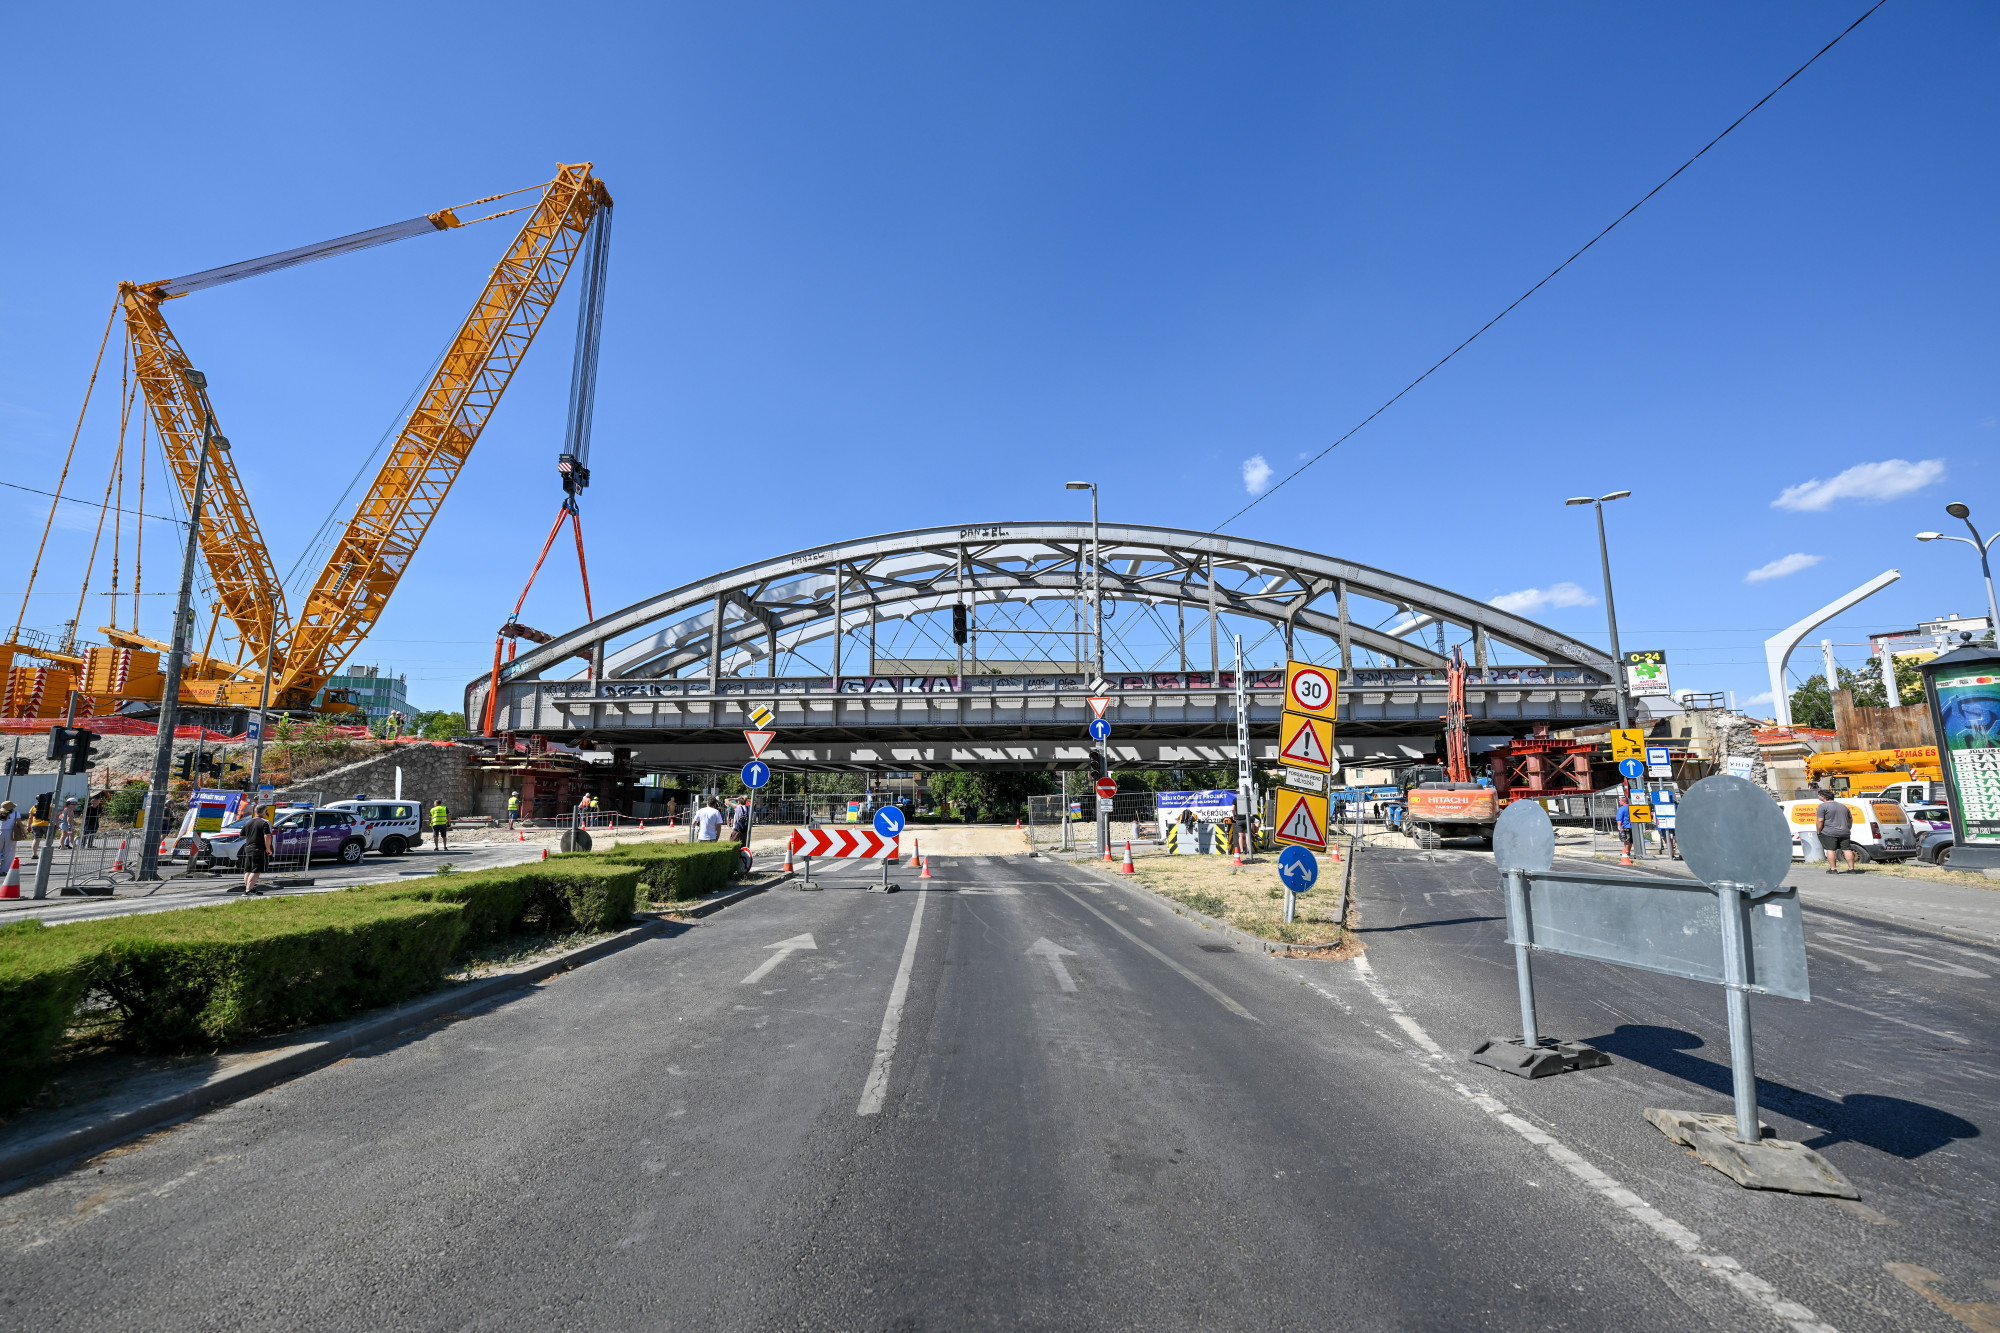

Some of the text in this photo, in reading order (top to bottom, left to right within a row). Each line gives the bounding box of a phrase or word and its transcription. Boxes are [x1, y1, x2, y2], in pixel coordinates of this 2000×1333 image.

[1630, 652, 1661, 662] 0-24
[1301, 680, 1322, 699] 30
[1894, 748, 1936, 758] TAMÁS ÉS
[1955, 763, 2000, 771] BRA
[1957, 771, 2000, 779] BRA
[1428, 796, 1469, 804] HITACHI
